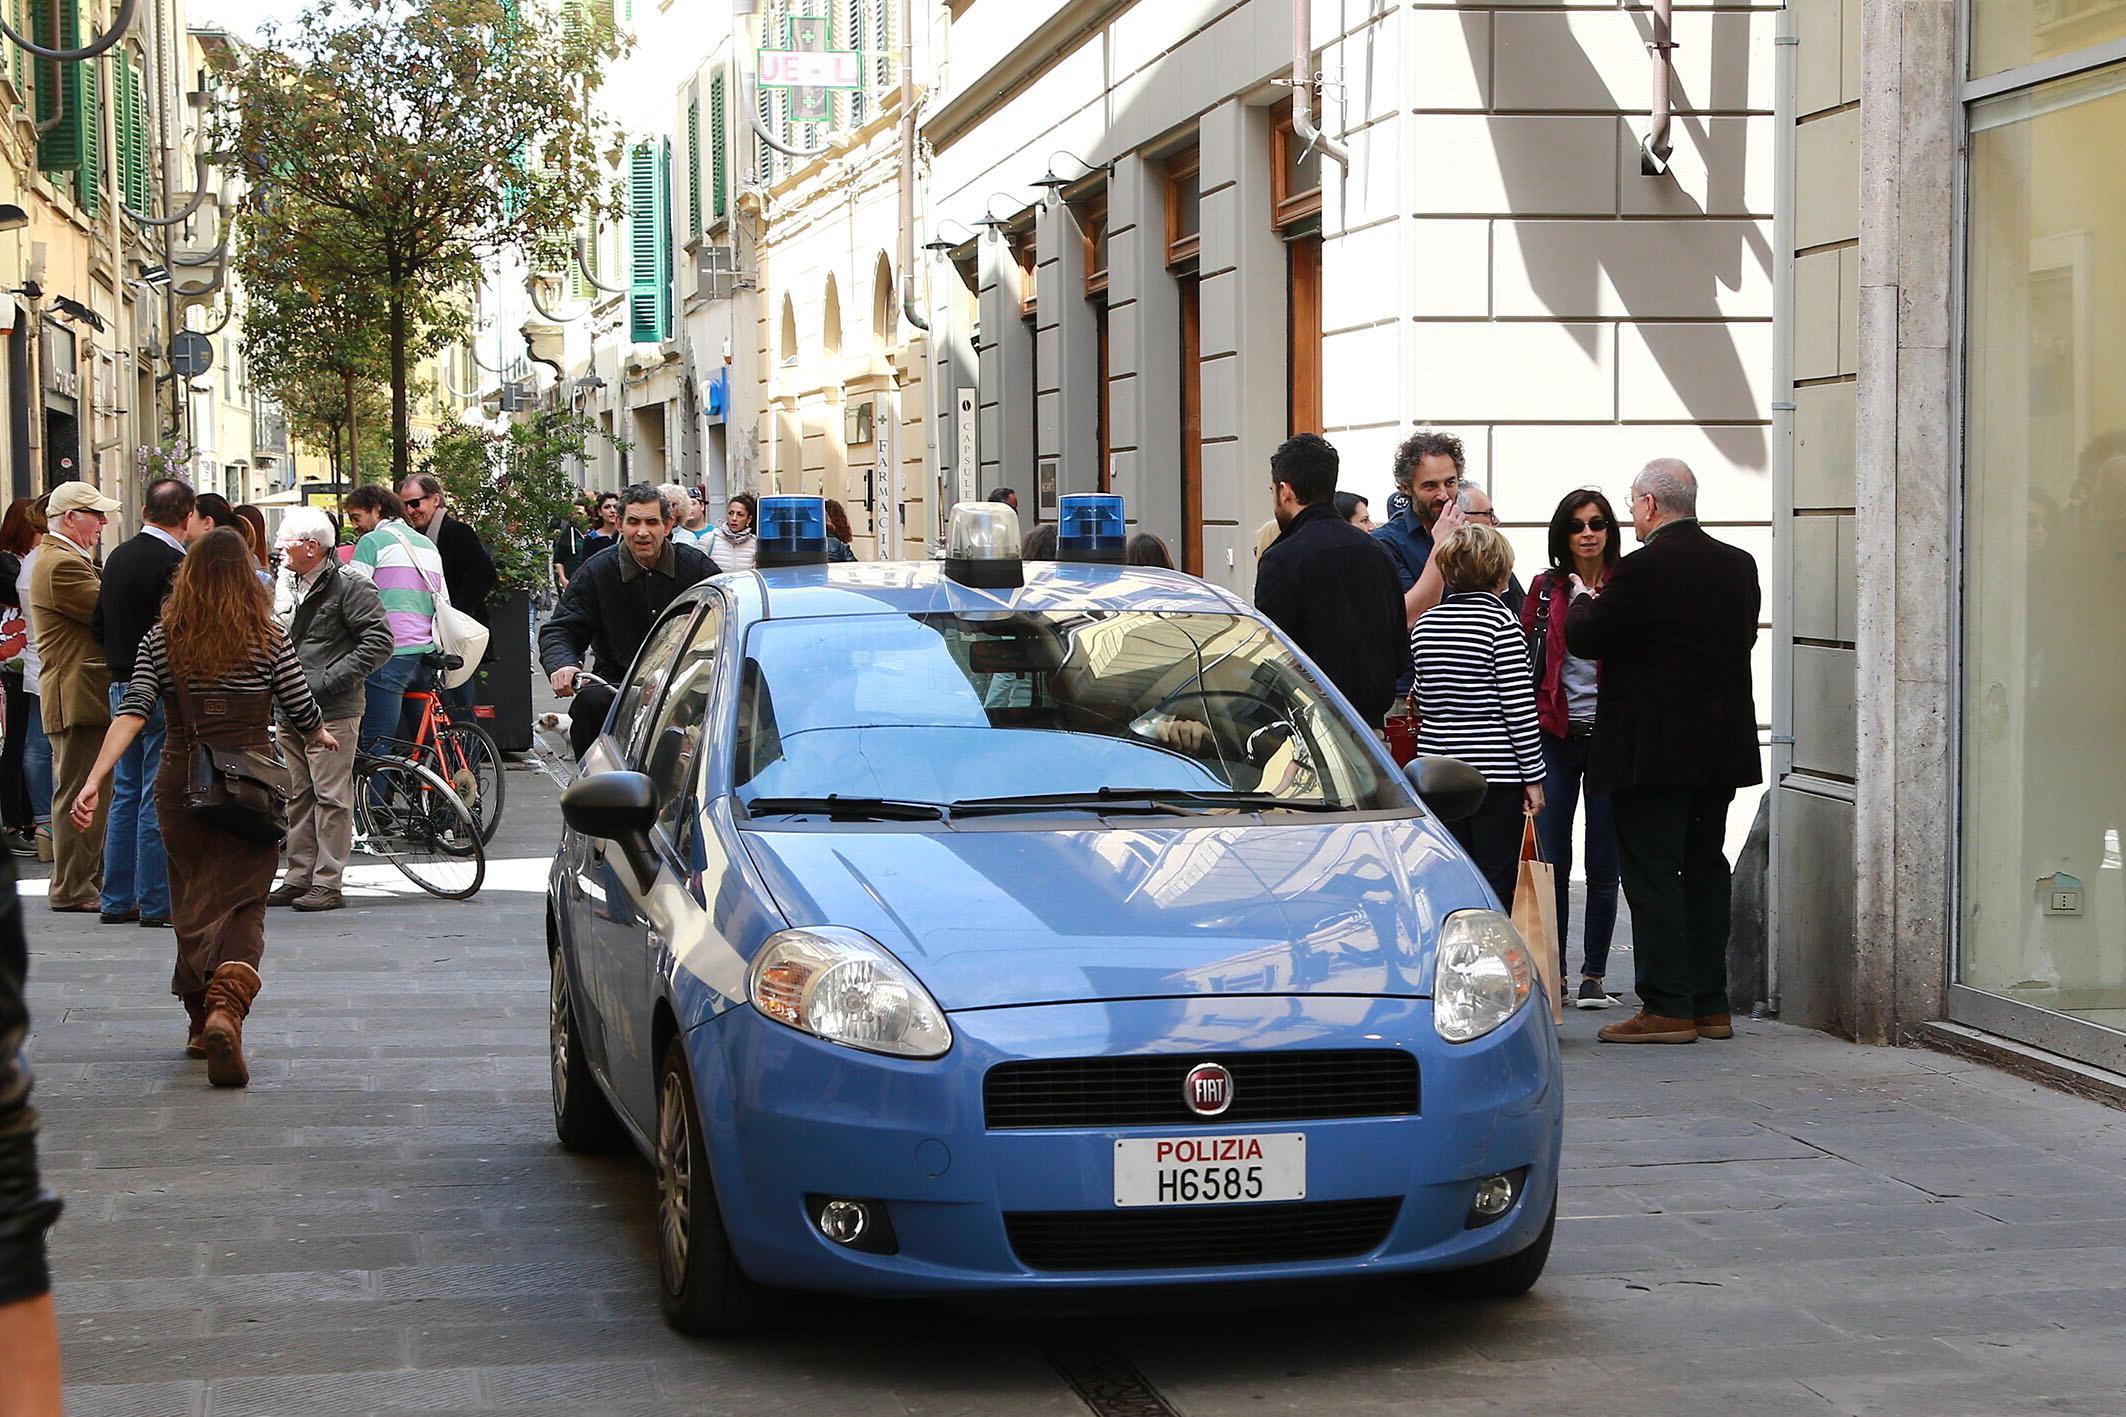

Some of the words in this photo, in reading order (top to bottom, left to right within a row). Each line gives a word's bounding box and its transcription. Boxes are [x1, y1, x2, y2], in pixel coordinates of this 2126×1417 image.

[962, 422, 971, 499] CAPSULE
[878, 439, 888, 560] FARMACIA
[1195, 1078, 1224, 1102] FIAT
[1157, 1138, 1263, 1163] POLIZIA
[1158, 1166, 1263, 1202] H6585
